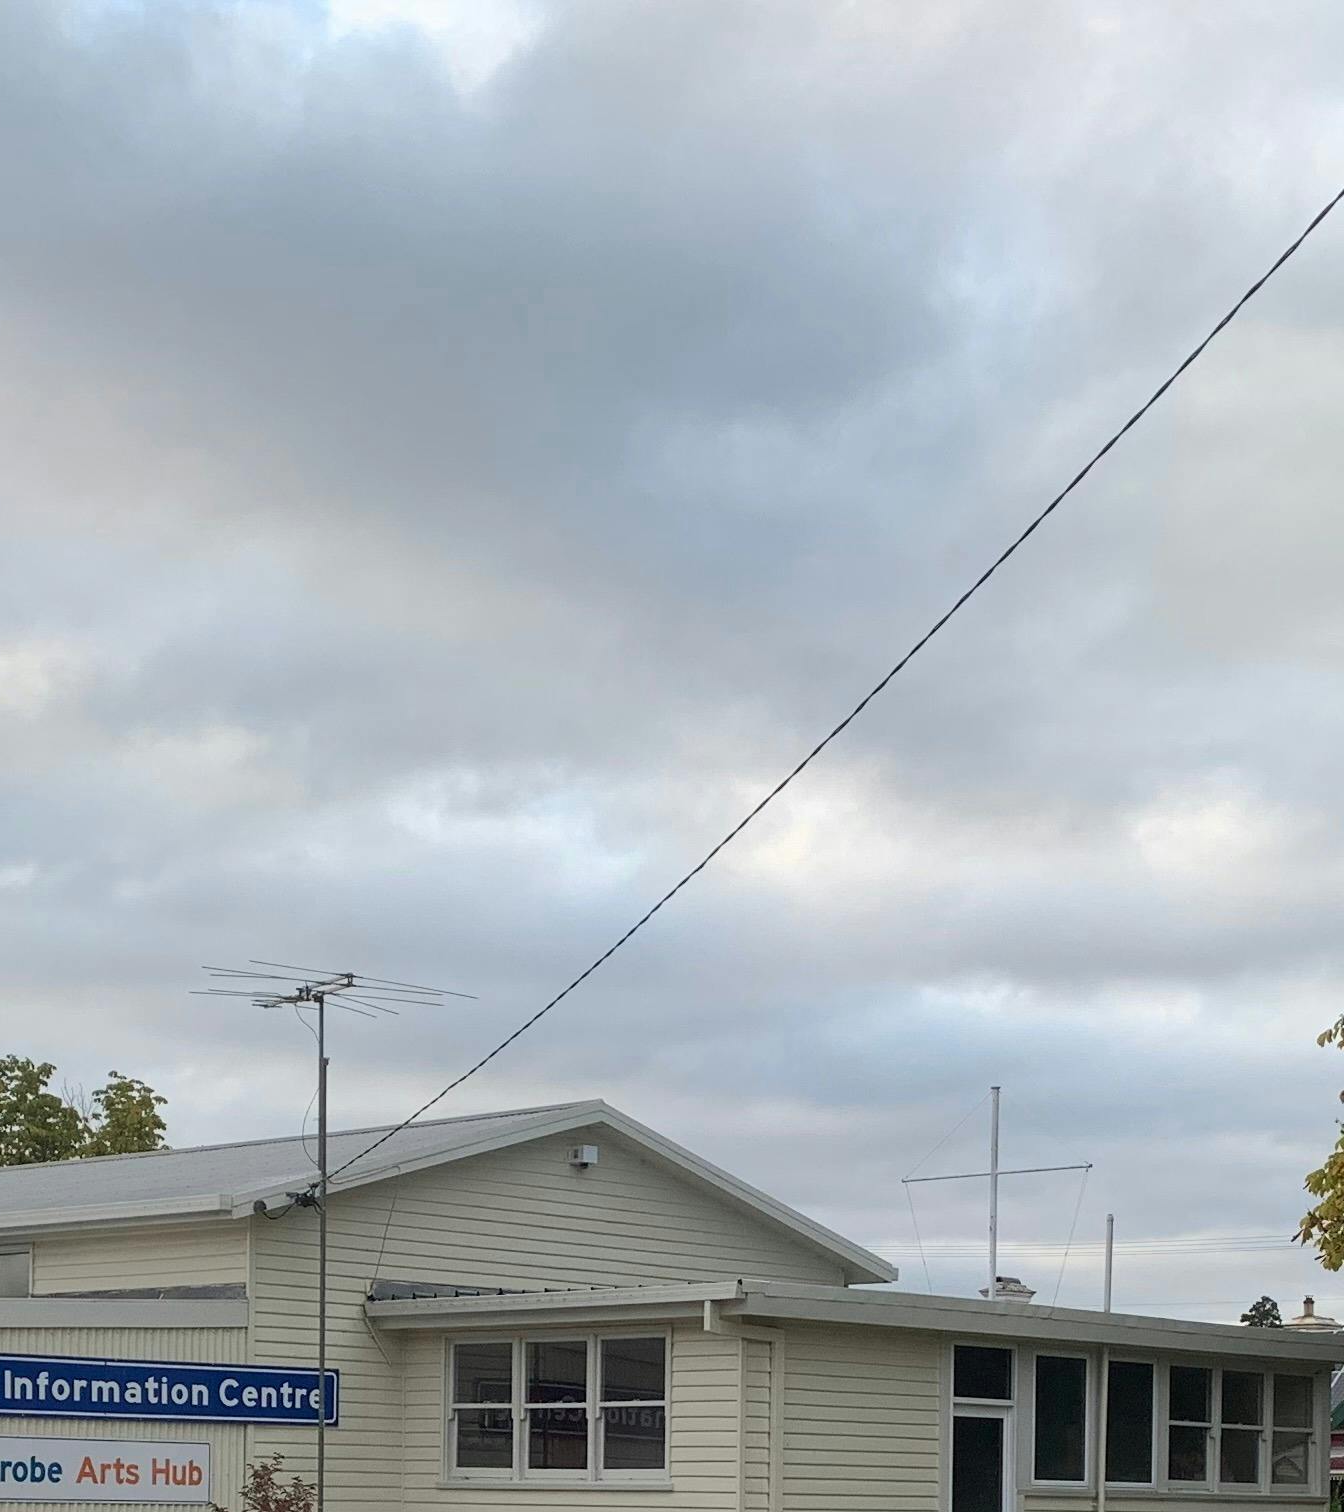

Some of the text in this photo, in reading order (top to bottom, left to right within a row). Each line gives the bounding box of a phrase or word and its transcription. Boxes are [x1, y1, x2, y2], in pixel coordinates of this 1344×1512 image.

[4, 1369, 209, 1406] Information
[219, 1378, 321, 1409] Centre
[75, 1456, 140, 1485] Arts
[151, 1458, 203, 1486] Hub
